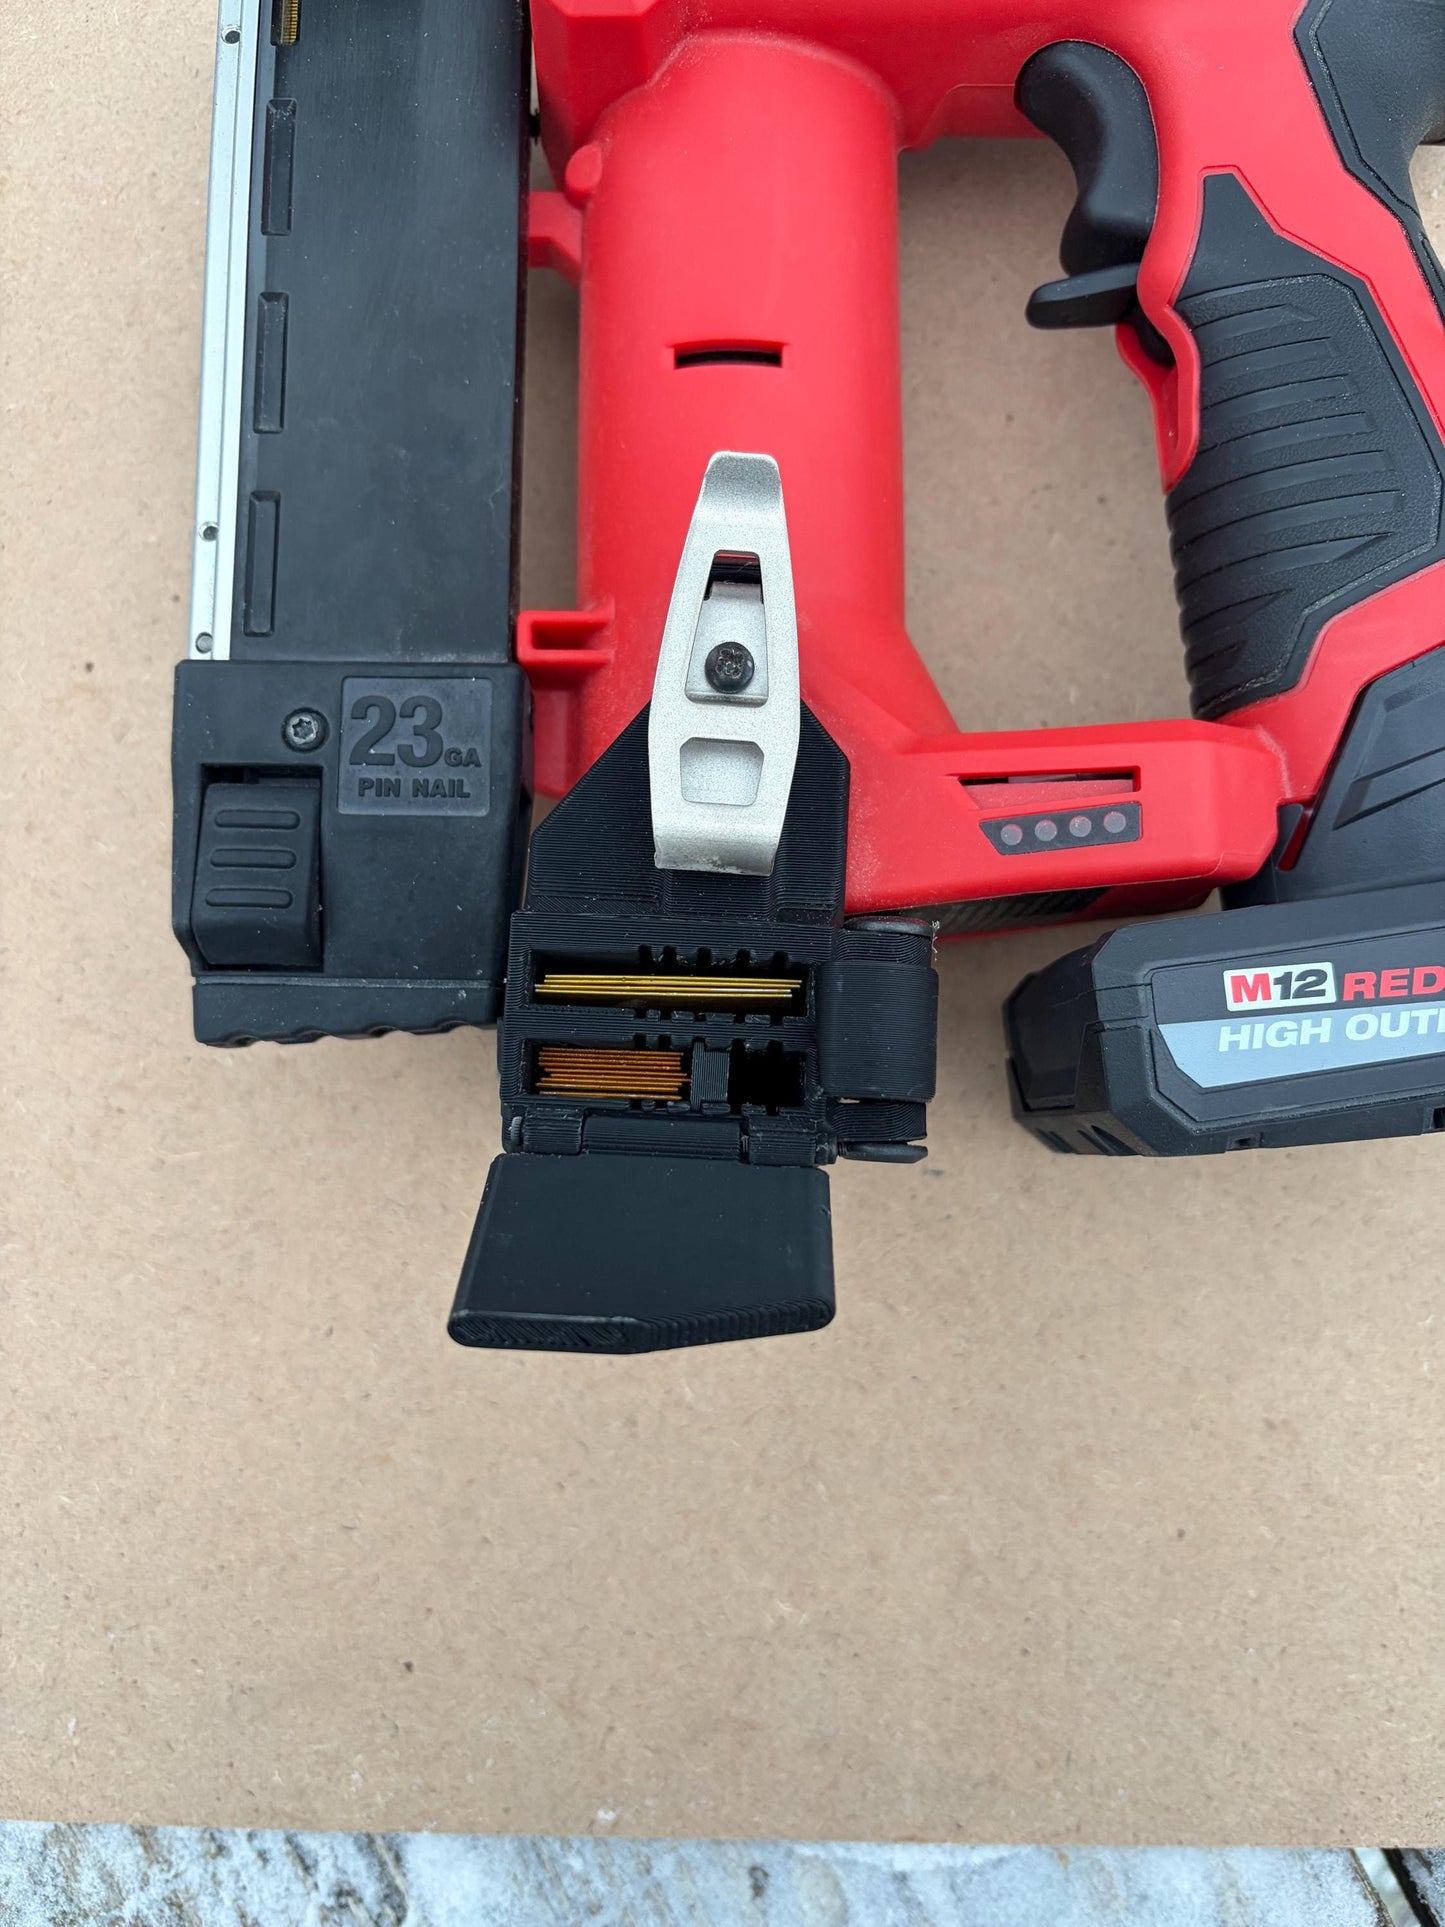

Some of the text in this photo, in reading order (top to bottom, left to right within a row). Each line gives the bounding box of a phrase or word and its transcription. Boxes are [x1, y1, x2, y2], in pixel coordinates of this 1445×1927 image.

[350, 695, 481, 767] 23 GA
[358, 777, 471, 798] PIN NAIL
[1230, 965, 1445, 1003] M12 RED
[1218, 1017, 1332, 1051] HIGH
